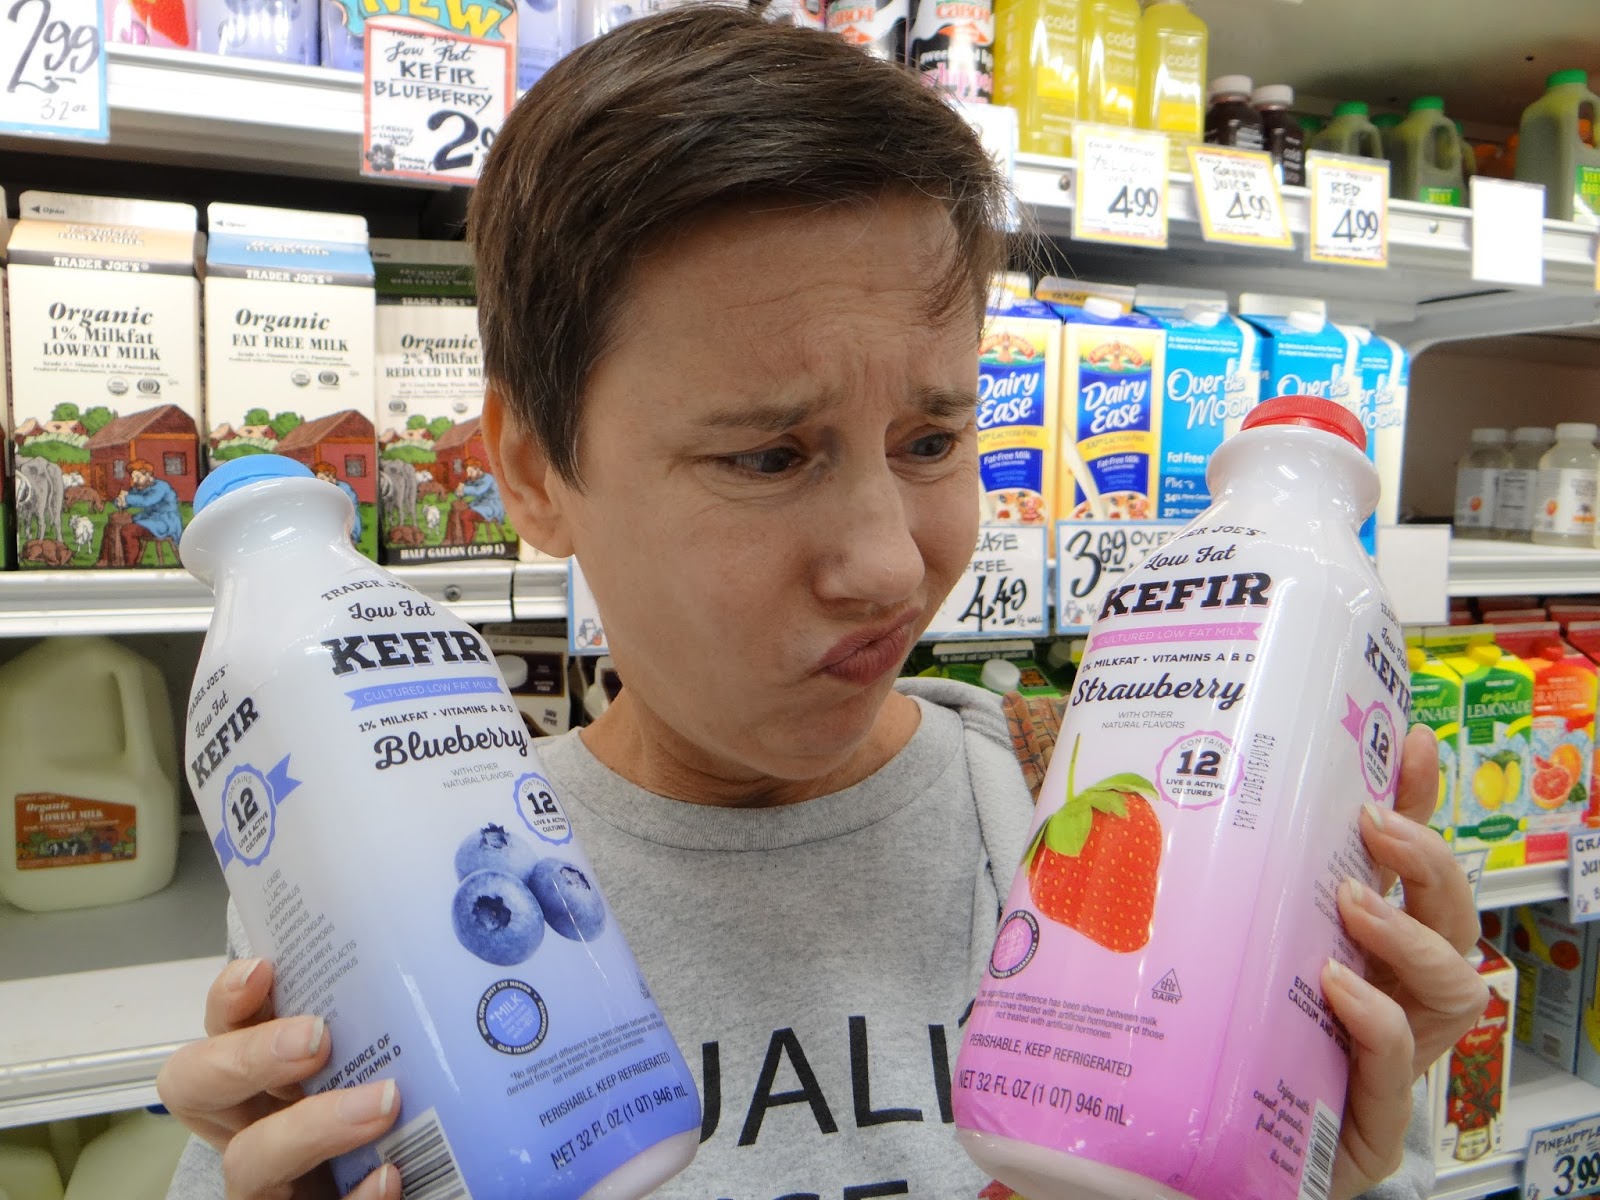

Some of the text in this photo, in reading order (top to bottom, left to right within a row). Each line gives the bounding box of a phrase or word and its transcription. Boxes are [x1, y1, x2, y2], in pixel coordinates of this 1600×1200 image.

[385, 41, 424, 62] Low
[400, 60, 475, 84] KEFIR
[373, 80, 493, 115] BLUEBERRY
[1331, 181, 1360, 197] RED
[53, 256, 102, 270] TRADER
[246, 269, 290, 282] TRADER
[49, 301, 153, 328] Organic
[235, 308, 330, 333] Organic
[51, 325, 153, 344] 1% Milkfat
[232, 334, 349, 352] FAT FREE MILK
[401, 334, 478, 355] Organic
[43, 343, 160, 361] LOWFAT MILK
[402, 353, 479, 365] 2% Milkfat
[386, 367, 463, 378] REDUCED FAT
[1167, 368, 1245, 401] Over the
[979, 371, 1040, 400] Dairy
[1081, 378, 1147, 411] Dairy
[977, 395, 1033, 428] Ease
[1090, 402, 1142, 435] Ease
[1186, 394, 1255, 431] Moon
[1015, 451, 1032, 461] Milk
[1097, 455, 1140, 469] Fat-Free Milk
[1167, 452, 1205, 464] Fat Free
[401, 547, 466, 560] HALF GALLON
[1144, 544, 1236, 571] Low Fat
[321, 579, 383, 602] TRADER
[1097, 572, 1272, 622] KEFIR
[348, 600, 436, 622] Low Fat
[1097, 626, 1247, 646] CULTURED LOW FAT MILK
[320, 630, 491, 677] KEFIR
[1094, 653, 1211, 669] MILKFAT VITAMINS
[363, 680, 494, 703] CULTURED LOW FAT MILK
[1072, 672, 1247, 711] Strawberry
[359, 704, 488, 733] 1% MILKFAT VITAMINS
[1118, 710, 1173, 719] WITH OTHER
[1467, 700, 1531, 719] LEMONADE
[1101, 720, 1185, 729] NATURAL FLAVORS
[191, 697, 259, 790] KEFIR
[373, 724, 528, 771] Blueberry
[1180, 737, 1230, 755] CONTAINS
[1370, 722, 1389, 767] 12
[451, 762, 499, 777] WITH OTHER
[1176, 749, 1222, 776] 12
[442, 770, 515, 790] NATURAL FLAVORS
[1172, 788, 1213, 797] CULTURES
[1194, 780, 1226, 790] ACTIVE
[231, 787, 259, 833] 12
[527, 791, 558, 815] 12
[245, 827, 267, 853] CULTURES
[275, 898, 304, 931] PLANTARUM
[319, 956, 359, 994] FLORENTINUS
[1015, 991, 1157, 1026] difference been shown between milk
[1152, 991, 1179, 1004] DAIRY
[1288, 988, 1319, 1023] CALCIUM
[1006, 1011, 1112, 1039] treated artificial hormones.
[1017, 1003, 1165, 1040] treated artificial hormones those
[344, 1033, 391, 1077] SOURCE OF
[357, 1051, 391, 1083] VITAMIN
[526, 1041, 588, 1078] significant difference
[969, 1033, 1133, 1078] PERISHABLE, KEEP REFRIGERATED
[507, 1078, 534, 1097] derived
[538, 1052, 671, 1128] PERISHABLE, KEEP REFRIGERATED
[959, 1069, 1127, 1126] NET 32 FL OZ QT) 946 mL
[550, 1082, 688, 1171] NET 32 FL OZ QT) 946 mL
